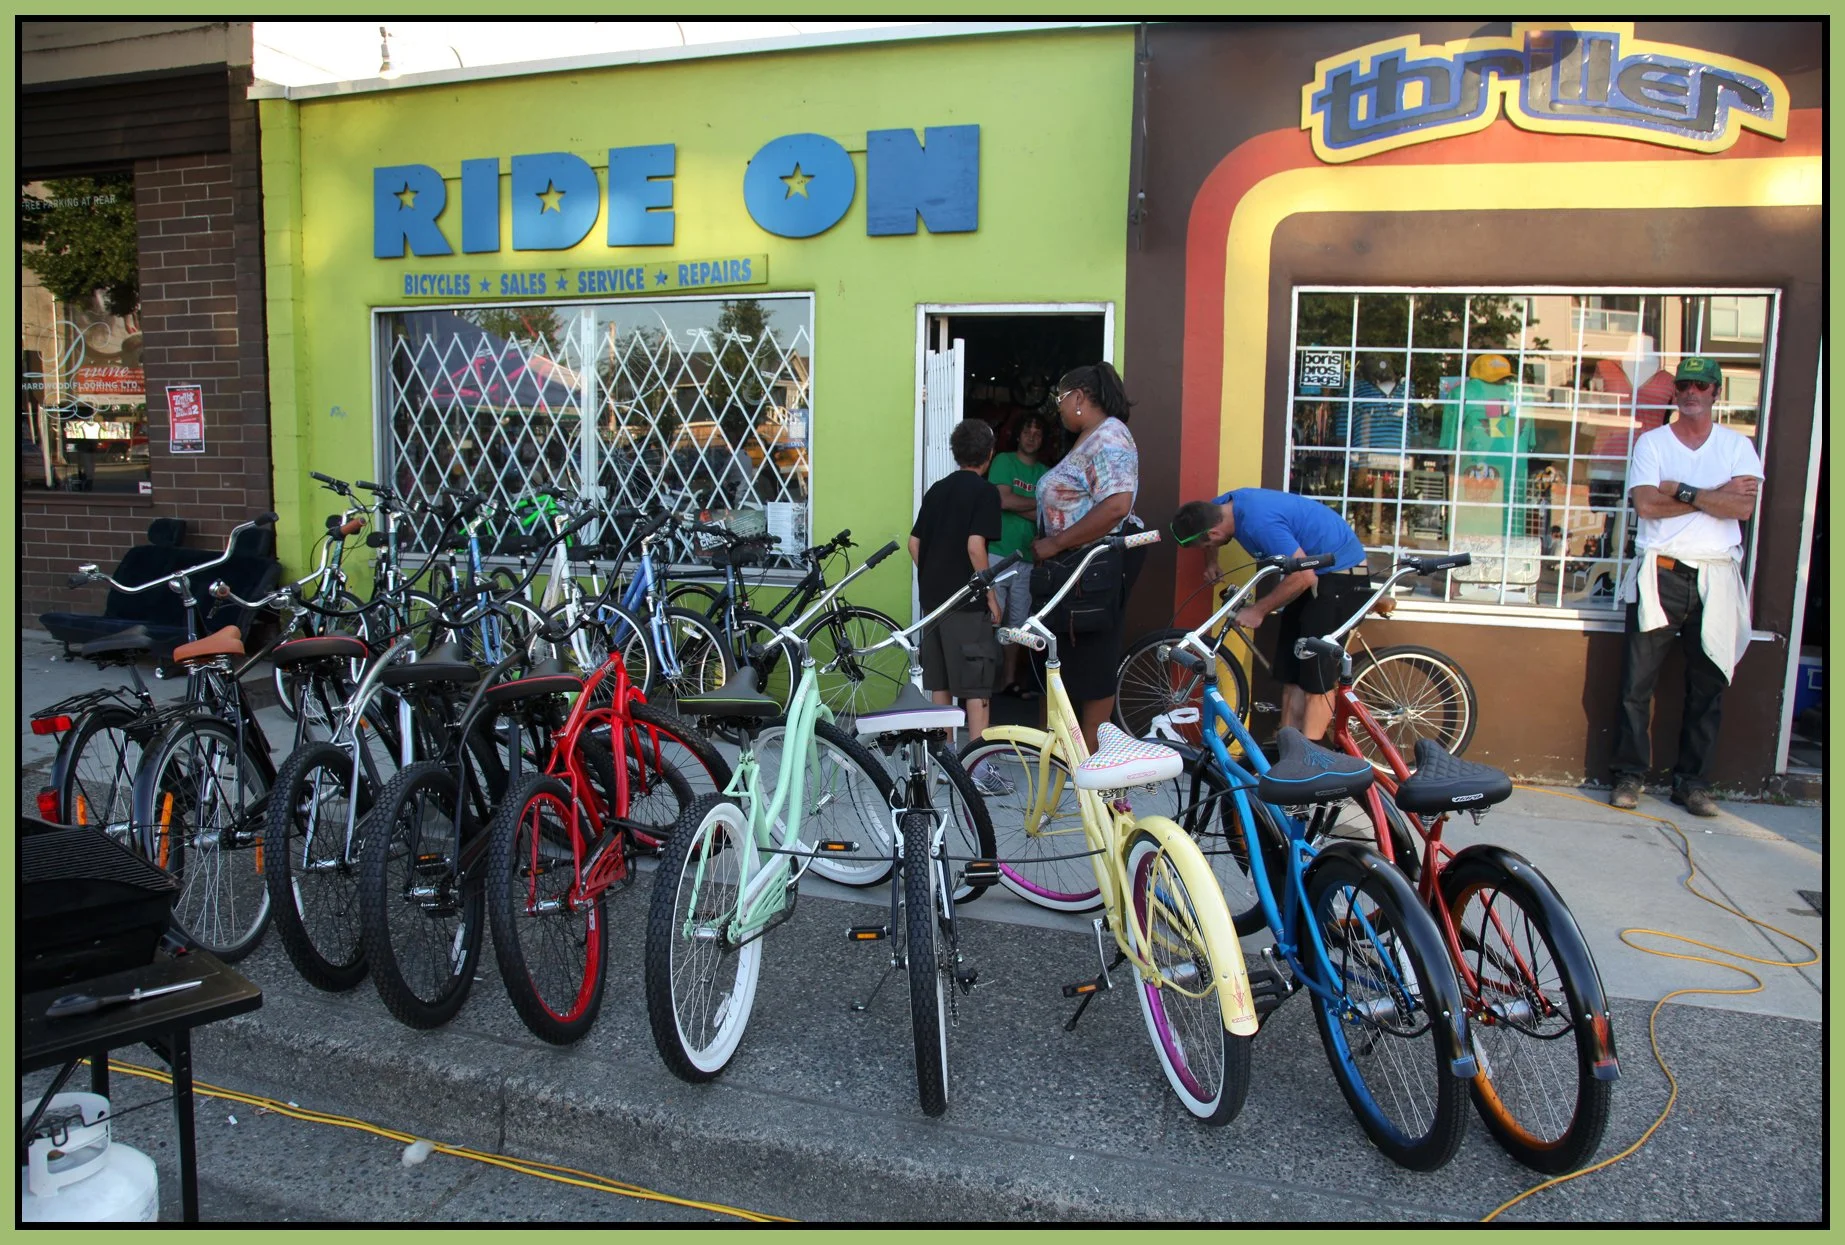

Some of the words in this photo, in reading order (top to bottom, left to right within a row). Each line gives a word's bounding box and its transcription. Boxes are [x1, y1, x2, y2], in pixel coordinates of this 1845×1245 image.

[1312, 30, 1774, 145] thriller
[43, 197, 79, 209] PARKING
[81, 196, 91, 207] AT
[93, 194, 116, 205] REAR
[373, 143, 677, 259] RIDE
[742, 123, 981, 240] ON
[404, 273, 472, 296] BICYCLES
[500, 272, 547, 295] SALES
[578, 267, 645, 293] SERVICE
[678, 258, 752, 287] REPAIRS
[22, 382, 70, 391] HARDWOOD
[72, 381, 118, 389] FLOORING
